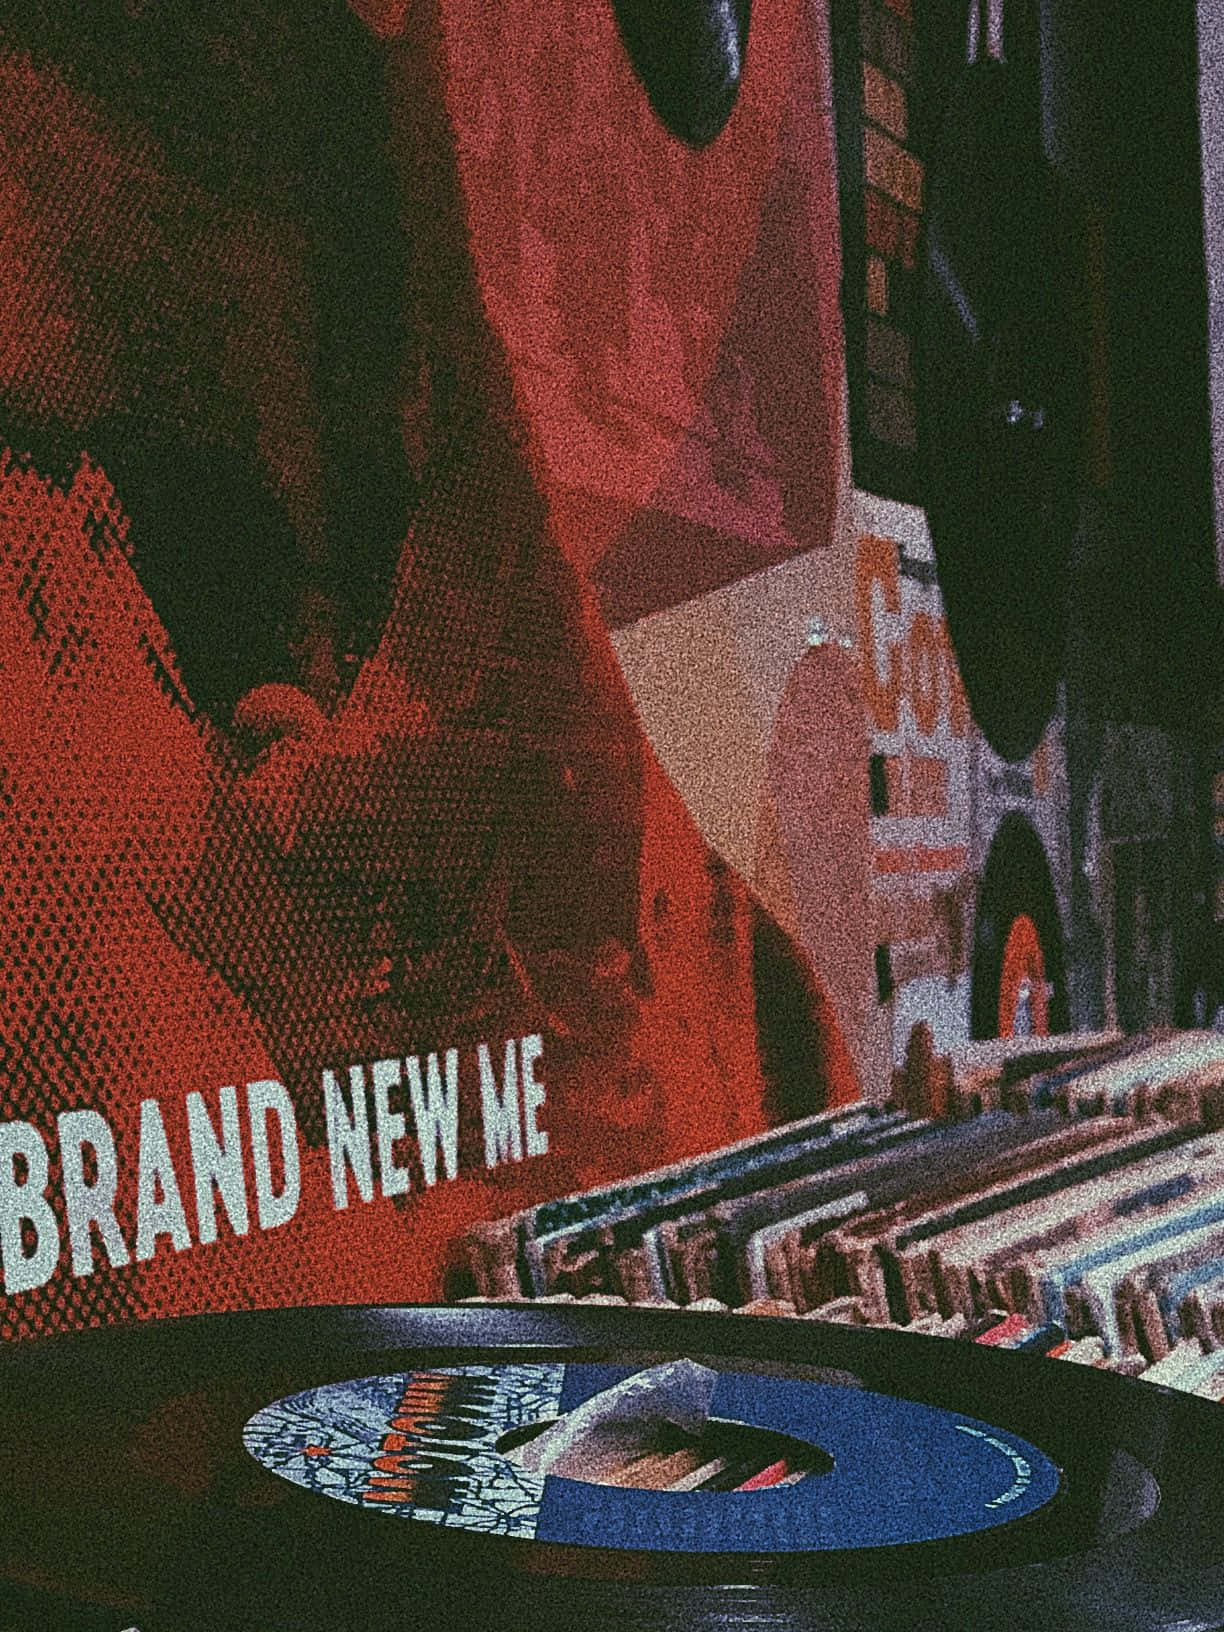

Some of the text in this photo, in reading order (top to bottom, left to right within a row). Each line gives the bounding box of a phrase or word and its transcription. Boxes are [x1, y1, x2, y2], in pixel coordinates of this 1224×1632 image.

[0, 1033, 550, 1296] BRAND NEW ME
